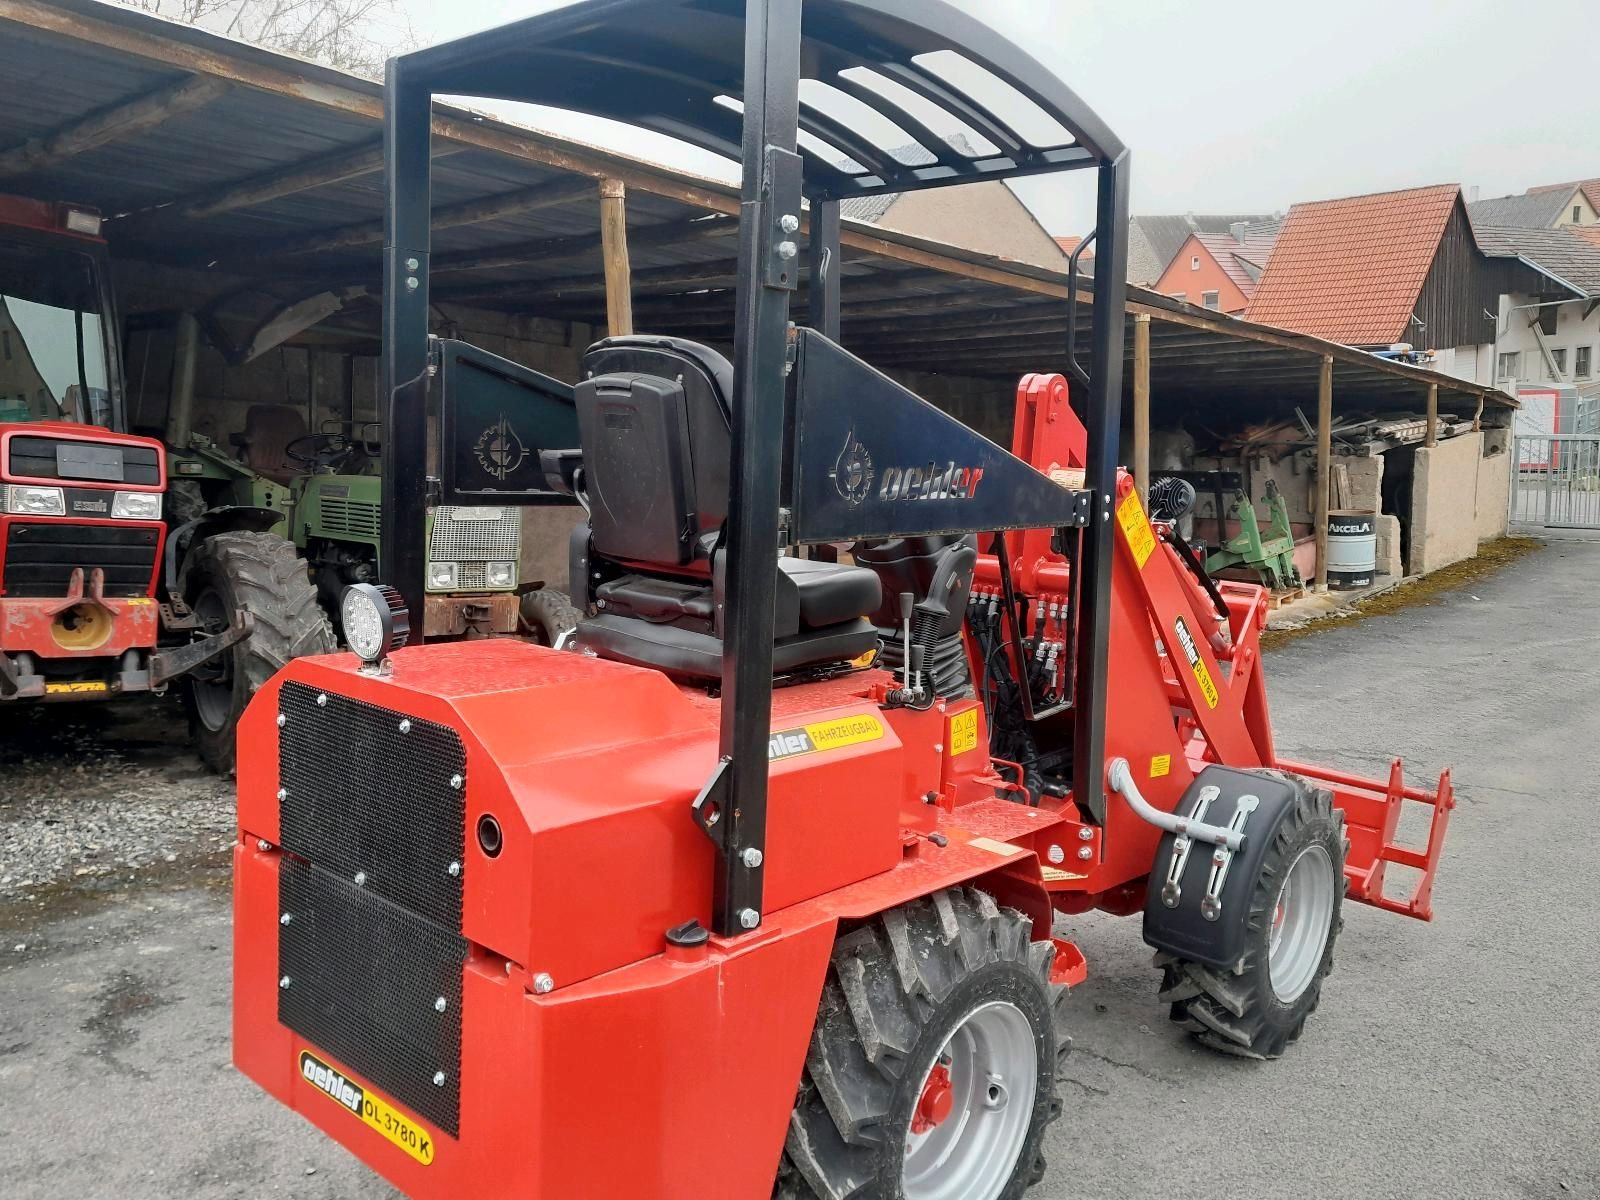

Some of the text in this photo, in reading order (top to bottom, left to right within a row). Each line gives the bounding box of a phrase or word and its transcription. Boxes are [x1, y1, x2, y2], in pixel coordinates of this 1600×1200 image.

[880, 461, 983, 500] oehler
[1328, 522, 1370, 533] AKCELA
[1175, 620, 1199, 665] oehler
[812, 719, 879, 743] FAHRZEUGBAU
[303, 1058, 430, 1159] oehler OL 3780 K
